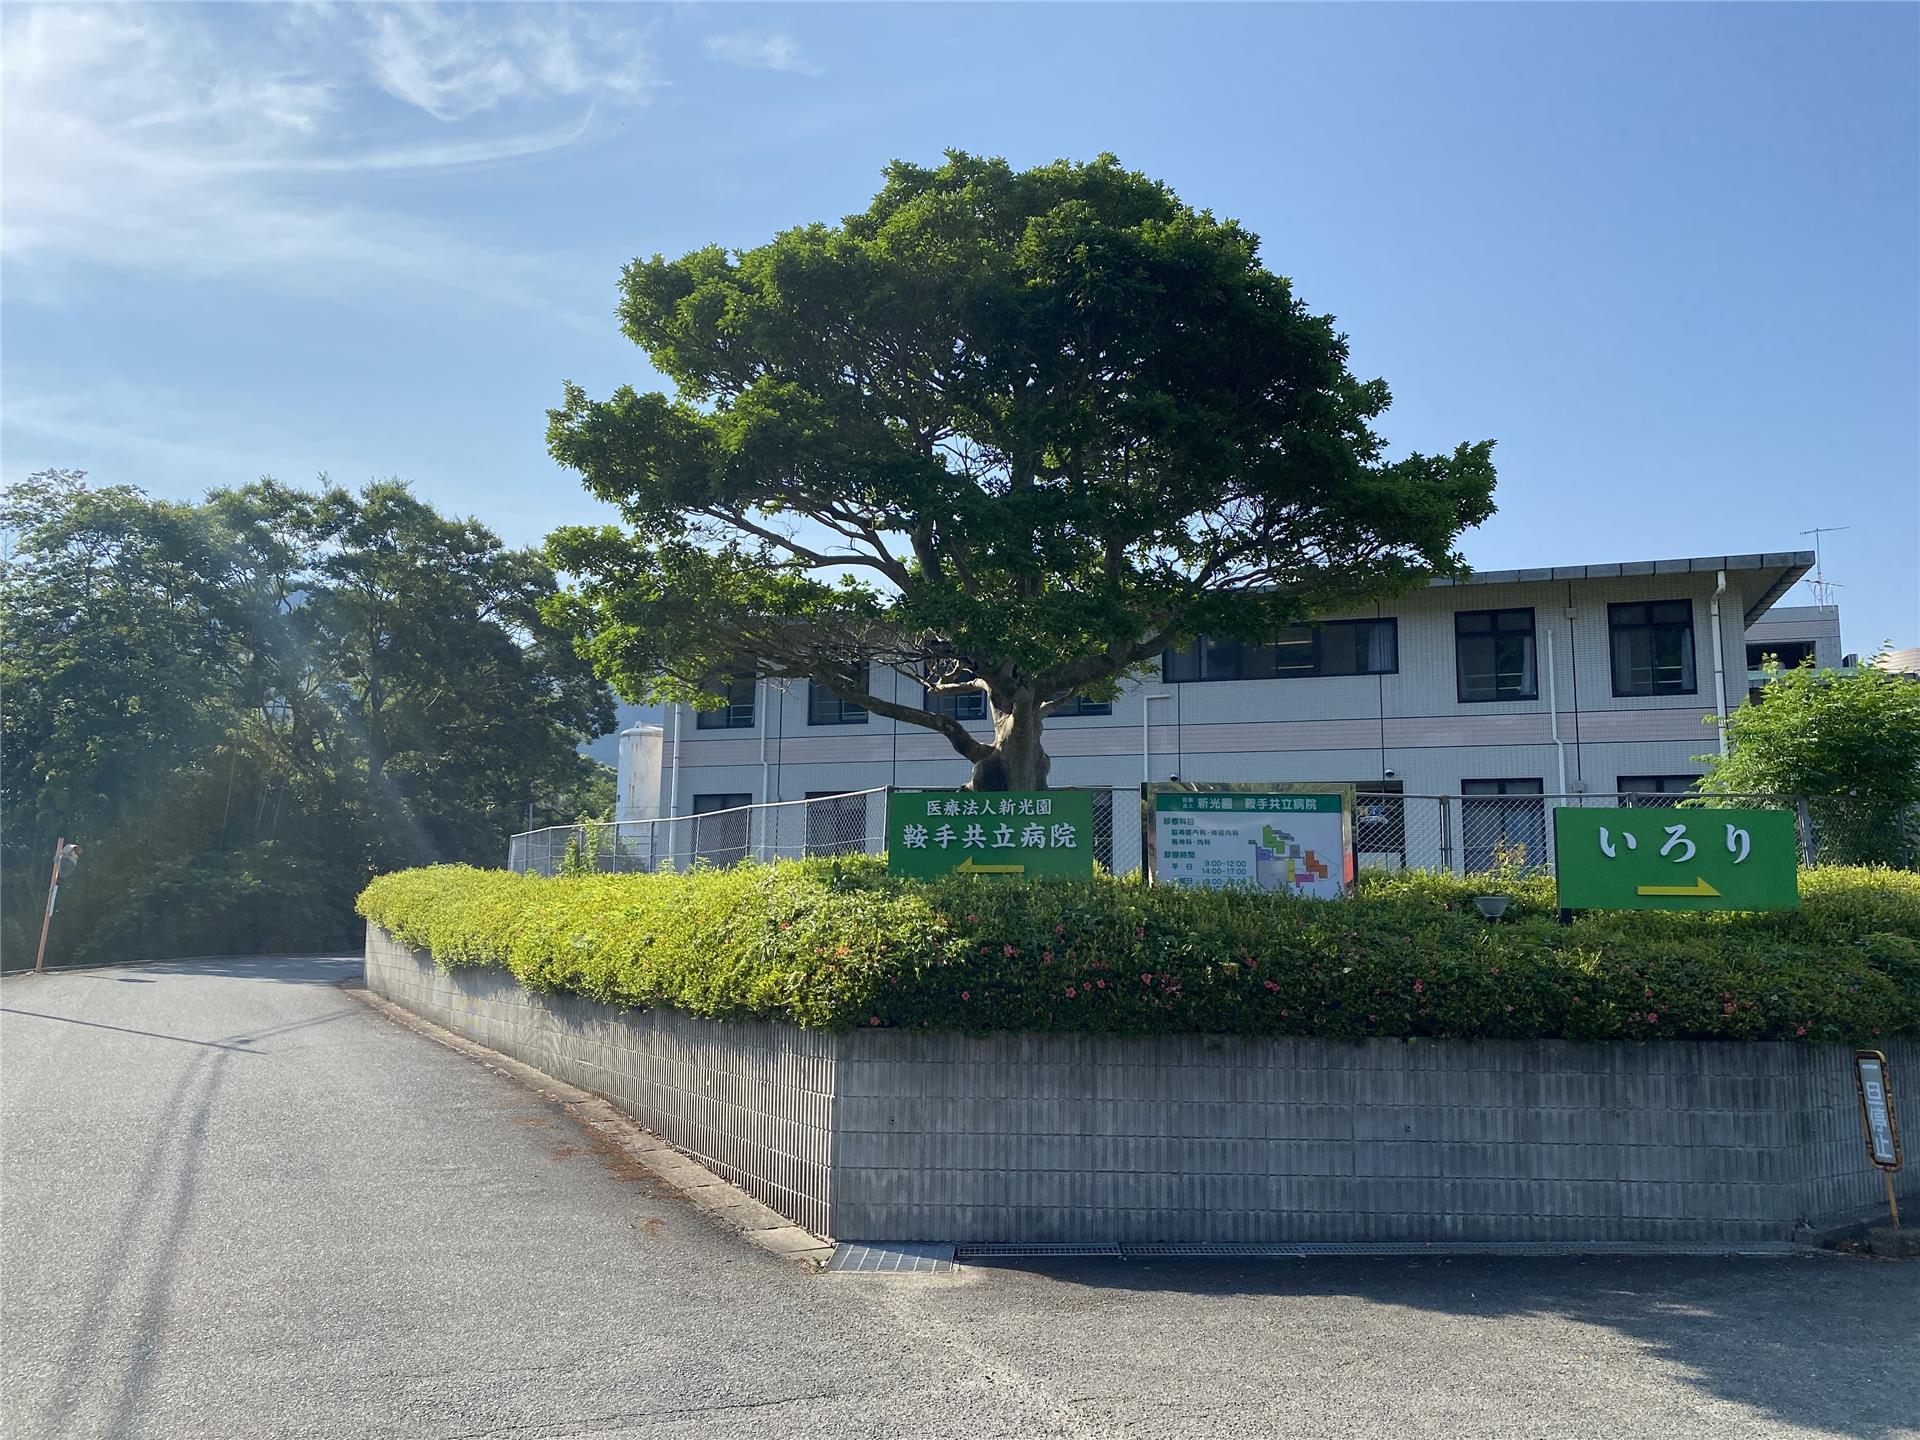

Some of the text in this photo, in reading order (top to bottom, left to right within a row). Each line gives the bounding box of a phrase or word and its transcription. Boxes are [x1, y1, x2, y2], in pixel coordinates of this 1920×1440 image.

[927, 799, 1051, 816] 医療法人新光園
[902, 823, 1077, 849] 鞍手共立病院
[1599, 824, 1750, 864] いろり
